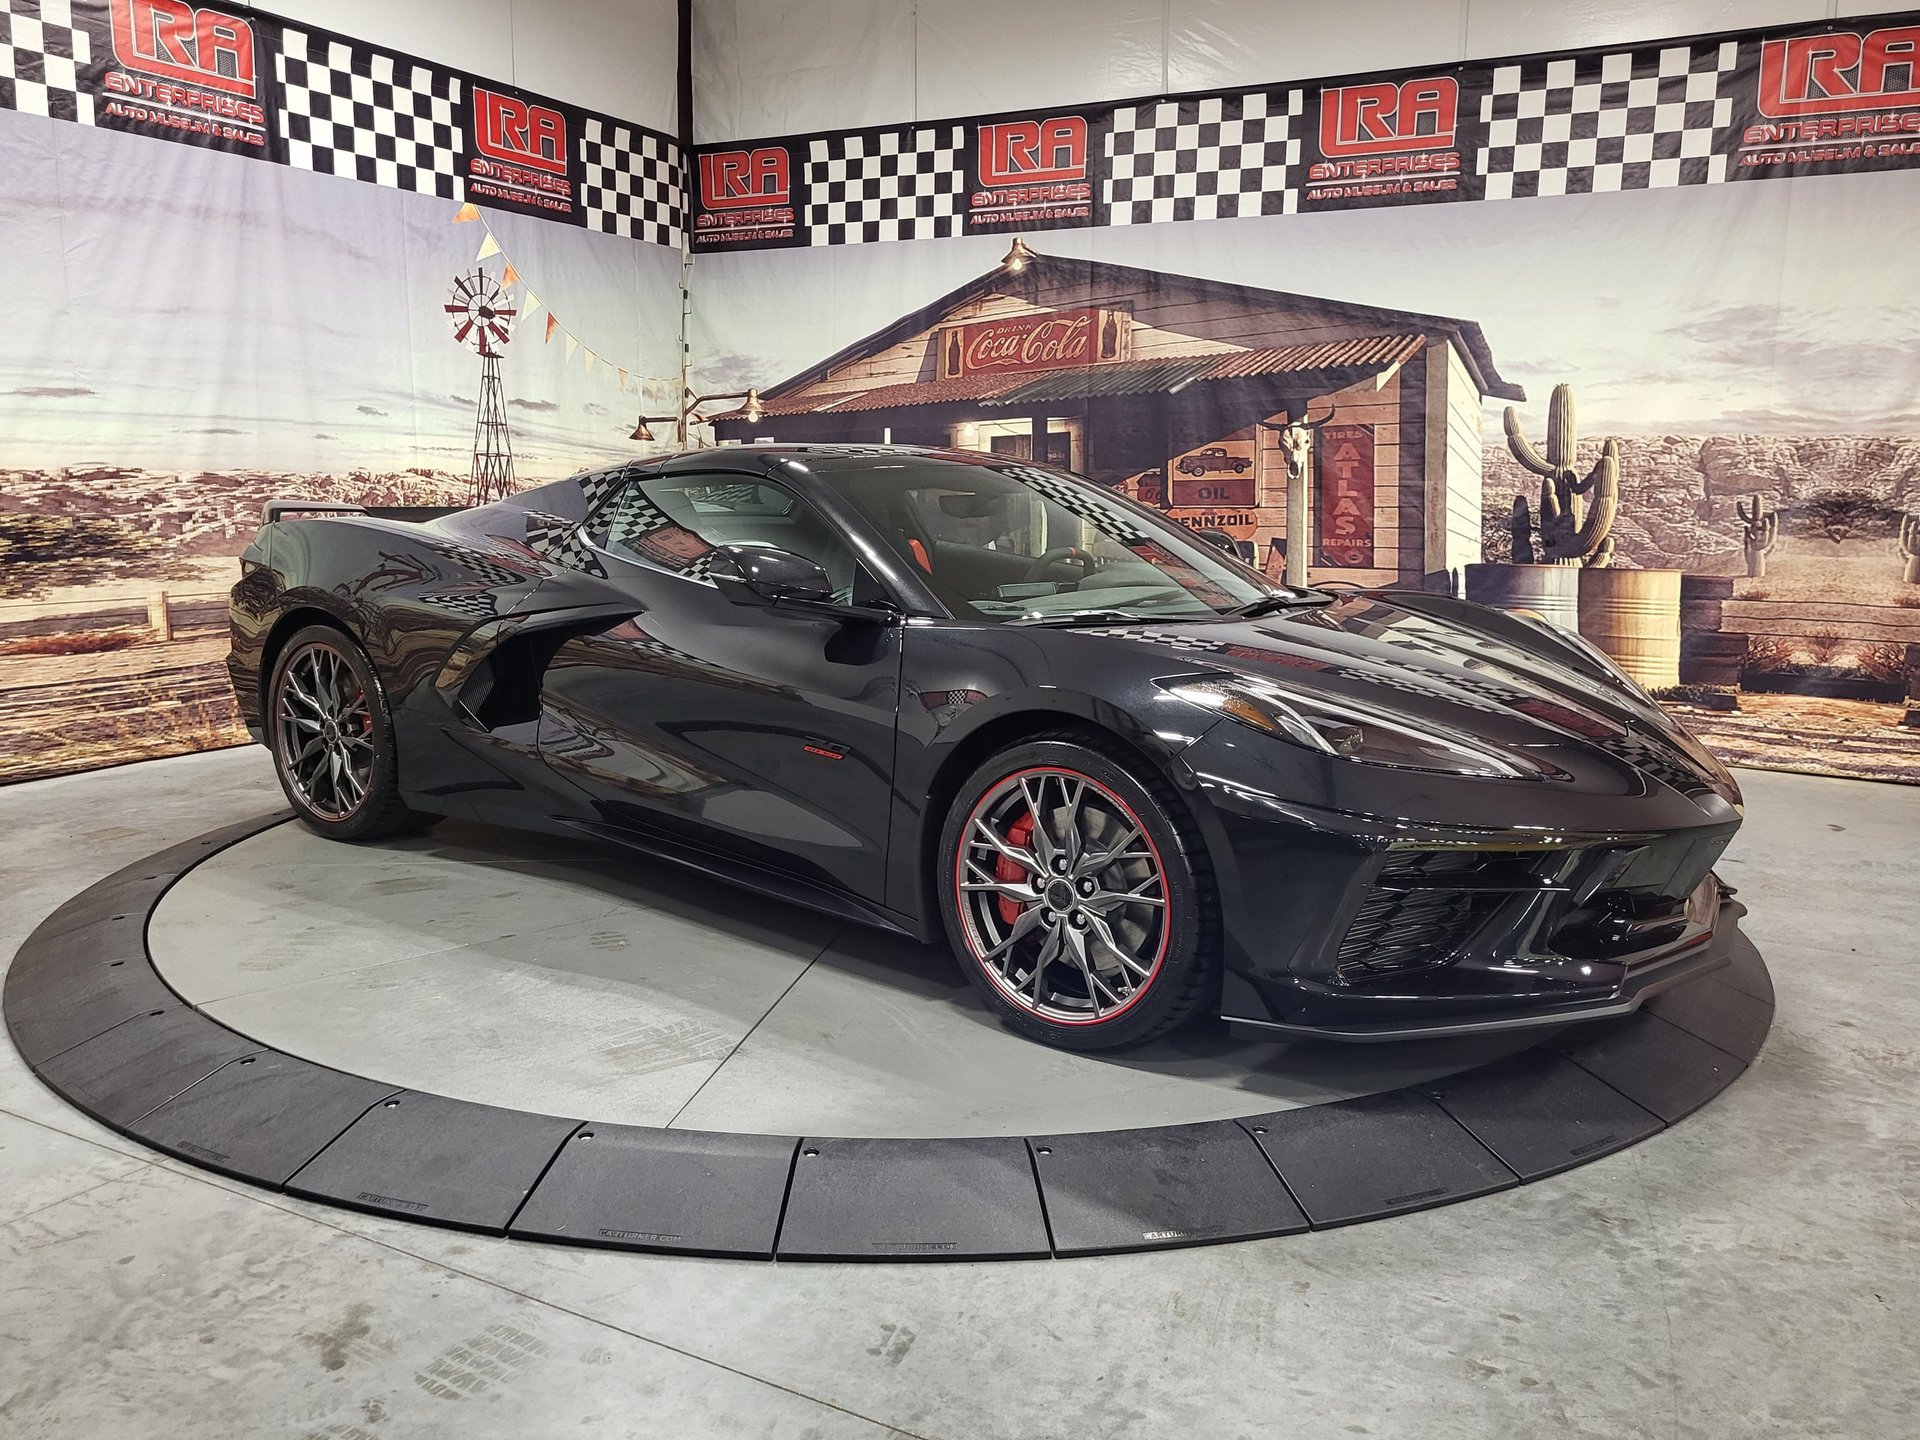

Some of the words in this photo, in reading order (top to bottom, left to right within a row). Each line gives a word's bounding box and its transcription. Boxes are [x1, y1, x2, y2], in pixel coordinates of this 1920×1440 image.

[104, 71, 265, 124] ENTERPRISES
[105, 102, 148, 121] AUTO
[150, 111, 210, 135] MUSEUM
[212, 125, 222, 138] &
[222, 127, 265, 147] SALES
[1318, 75, 1460, 159] LRA
[1743, 112, 1920, 144] ENTERPRISE
[472, 85, 568, 176] LRA
[978, 115, 1088, 187] LRA
[1738, 152, 1786, 167] AUTO
[1787, 146, 1861, 164] MUSEUM
[1863, 145, 1876, 158] &
[470, 158, 572, 196] ENTERPRISES
[1309, 151, 1461, 180] ENTERPRISES
[470, 182, 497, 197] AUTO
[698, 146, 790, 210] LRA
[1306, 186, 1343, 201] AUTO
[1343, 183, 1401, 198] MUSEUM
[1402, 181, 1412, 193] &
[1413, 178, 1457, 192] SALES
[971, 182, 1091, 207] ENTERPRISES
[696, 207, 795, 228] ENTERPRISES
[969, 213, 1000, 225] AUTO
[1053, 206, 1090, 218] SALES
[695, 234, 721, 245] AUTO
[996, 323, 1034, 335] DRINK
[1323, 431, 1363, 440] TIRES
[1197, 487, 1230, 499] OIL
[1333, 443, 1361, 535] ATLAS
[1174, 513, 1254, 528] ENNZOIL
[1322, 538, 1372, 547] REPAIRS
